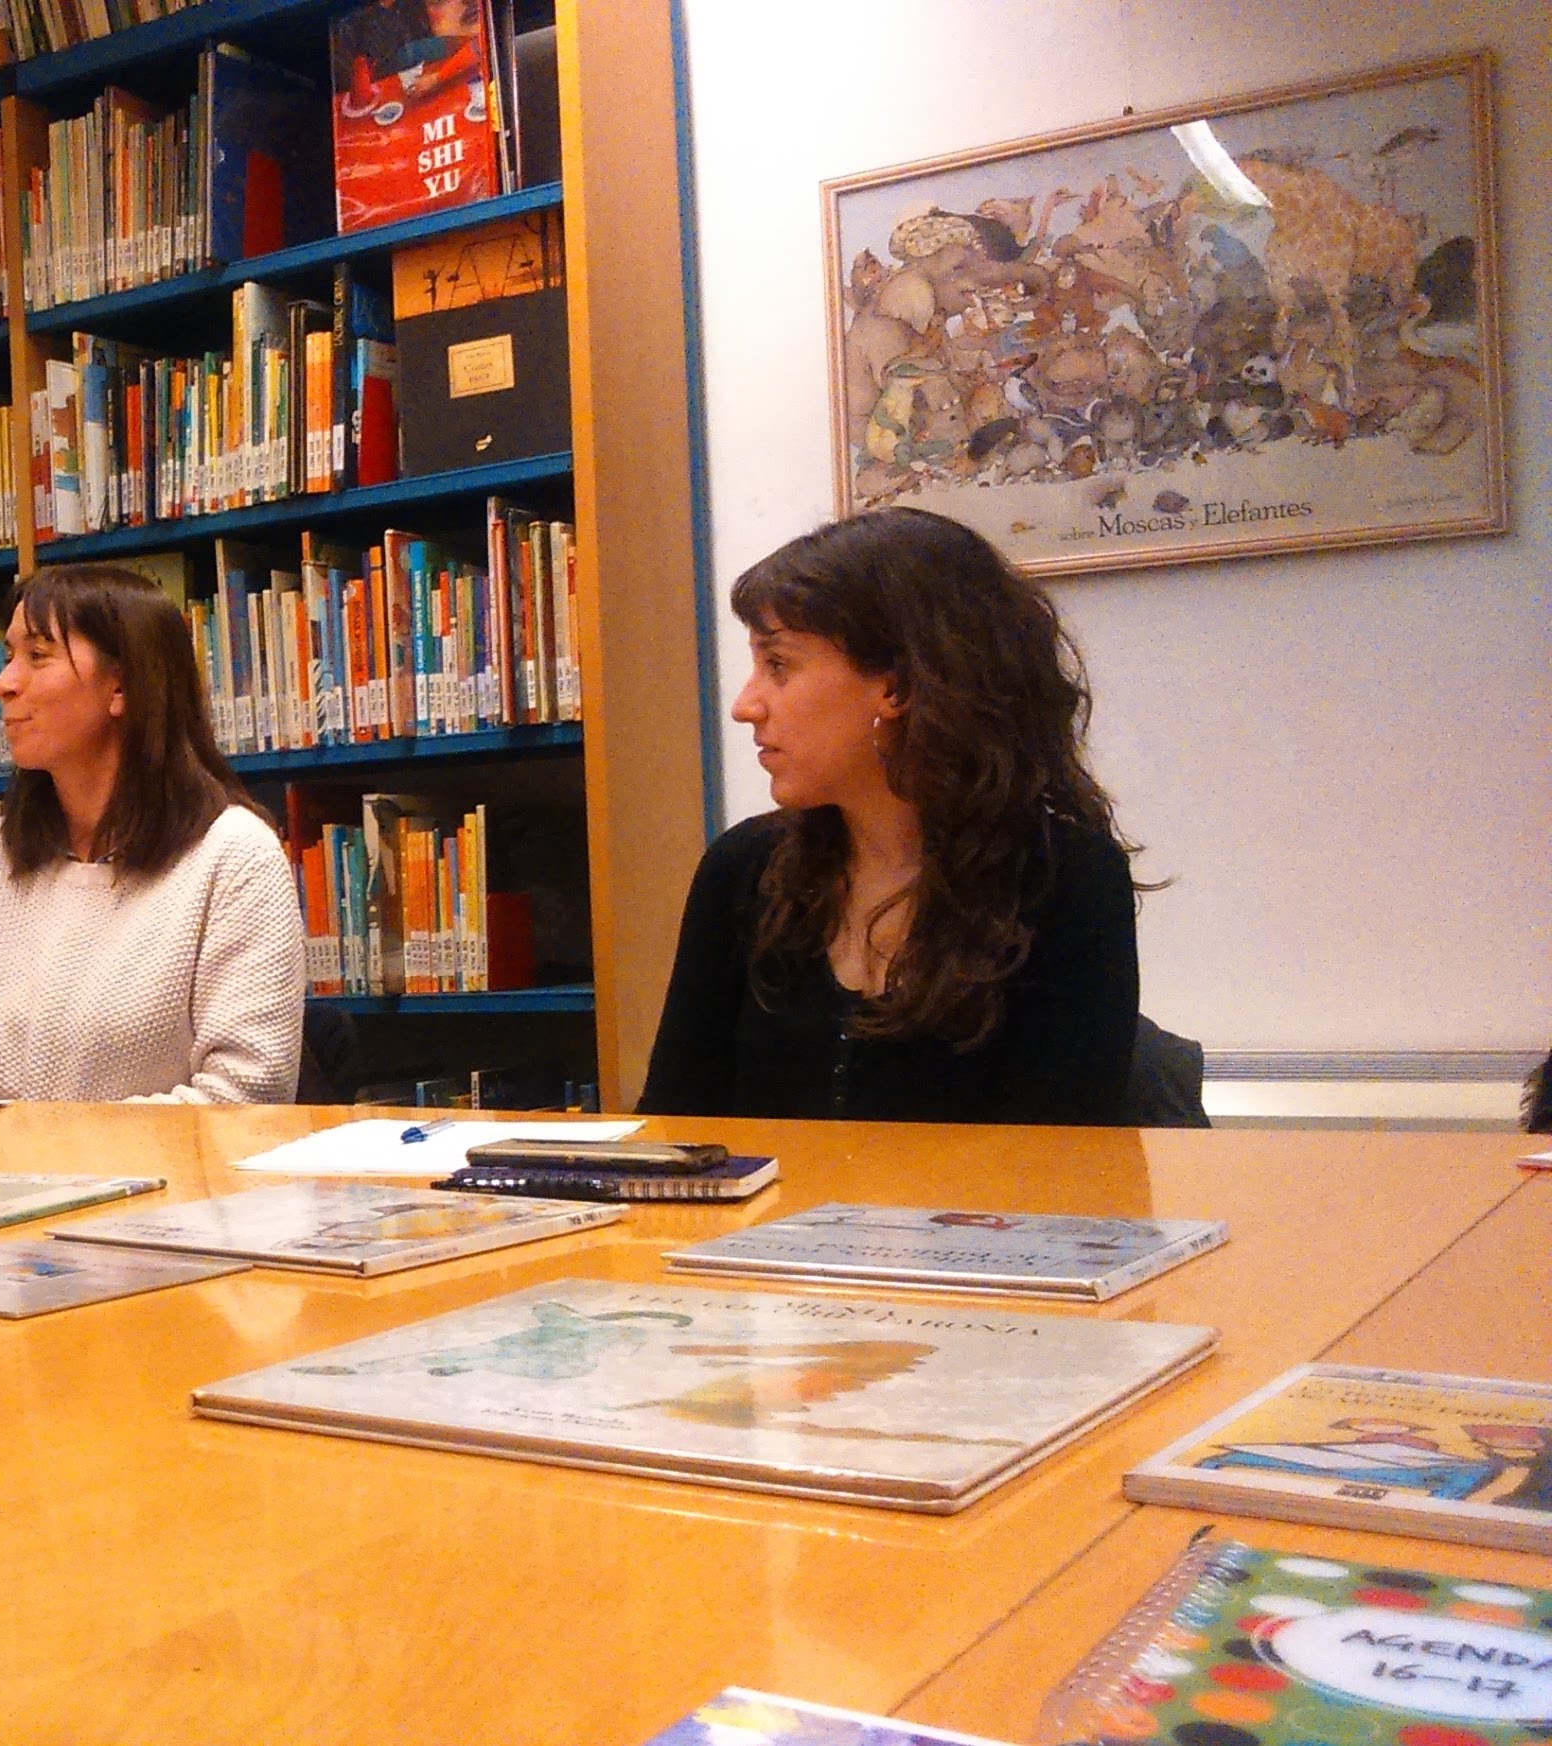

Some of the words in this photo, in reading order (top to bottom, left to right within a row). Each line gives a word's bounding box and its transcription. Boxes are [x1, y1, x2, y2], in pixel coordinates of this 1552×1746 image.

[422, 113, 455, 144] MI
[417, 140, 465, 174] SHI
[423, 168, 460, 198] YU
[1058, 527, 1094, 541] sobre
[1098, 514, 1185, 537] Moscas
[1203, 500, 1312, 527] Elefantes
[1370, 1662, 1521, 1700] 16-17
